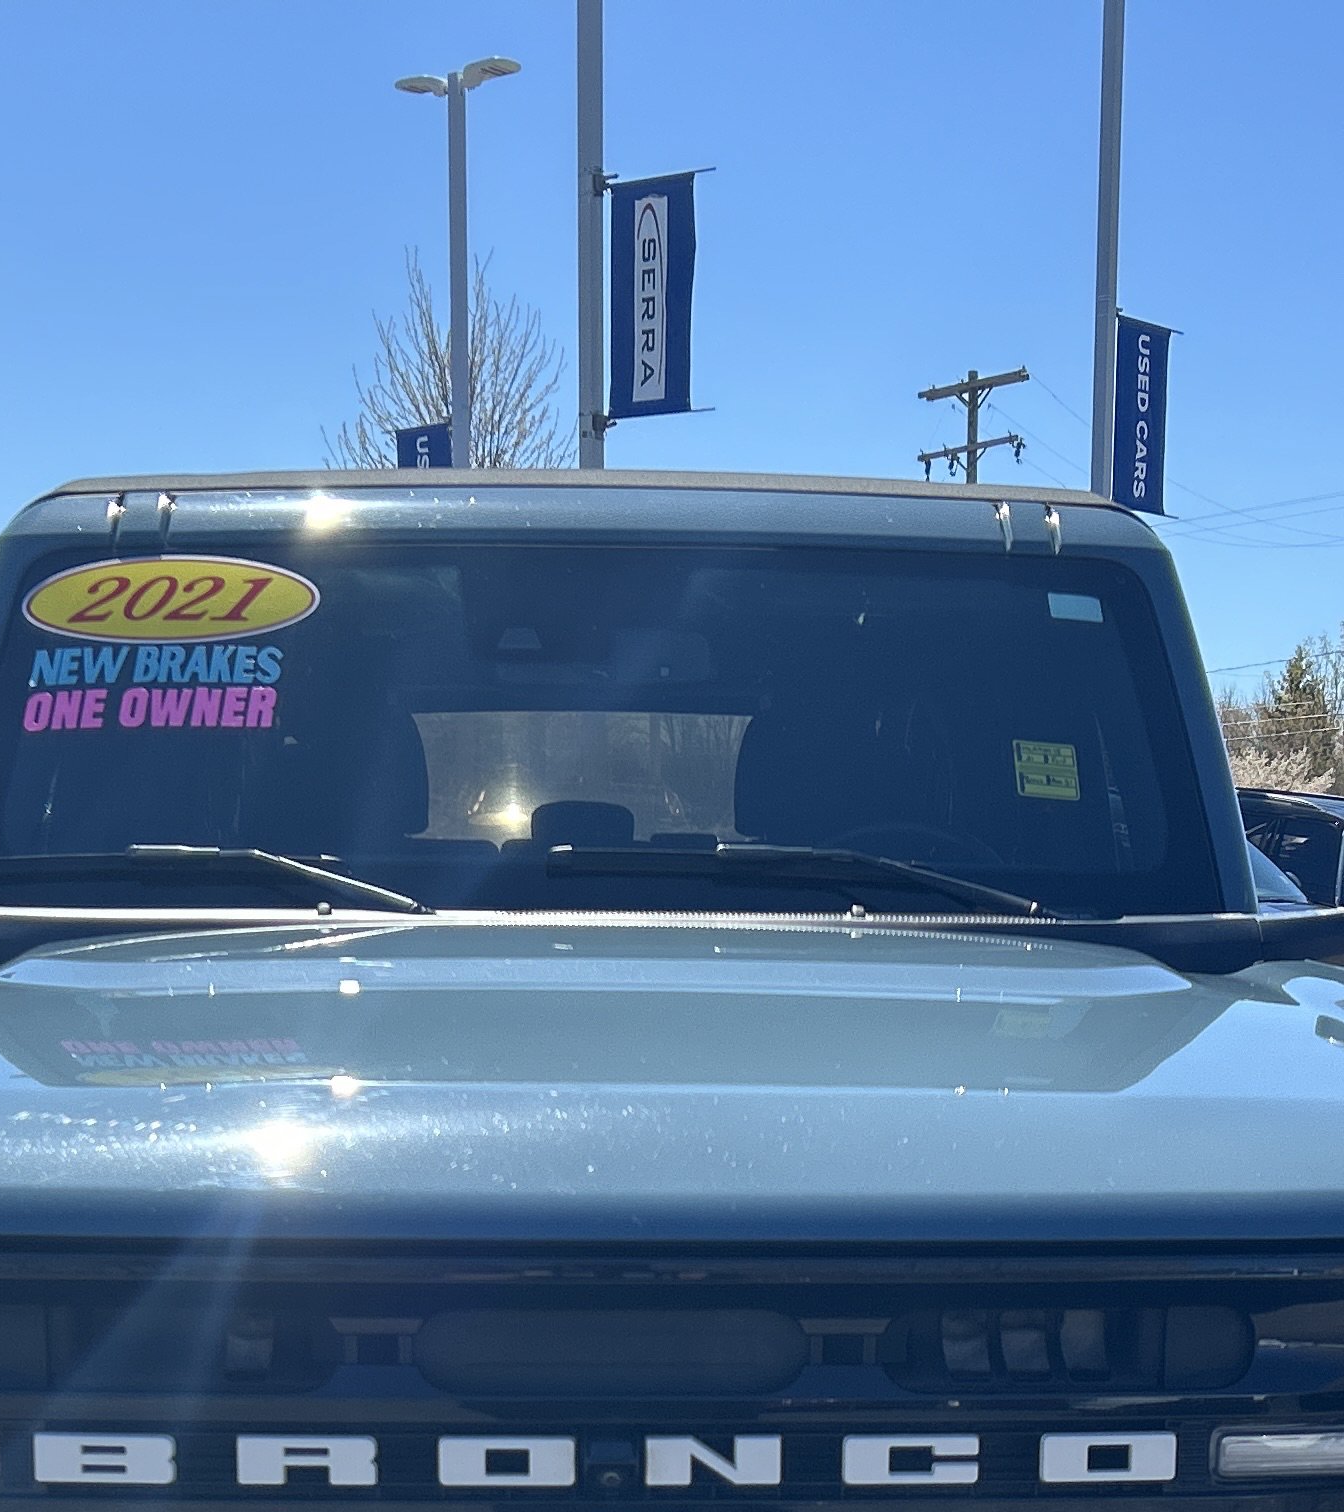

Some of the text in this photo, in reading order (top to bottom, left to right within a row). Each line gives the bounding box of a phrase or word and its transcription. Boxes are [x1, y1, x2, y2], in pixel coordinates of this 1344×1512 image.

[640, 237, 656, 387] SERRA
[1132, 334, 1151, 499] USED CARS
[67, 575, 273, 624] 2021
[29, 644, 285, 687] NEW BRAKES
[23, 685, 279, 732] ONE OWNER
[33, 1431, 1177, 1487] BRONCO
